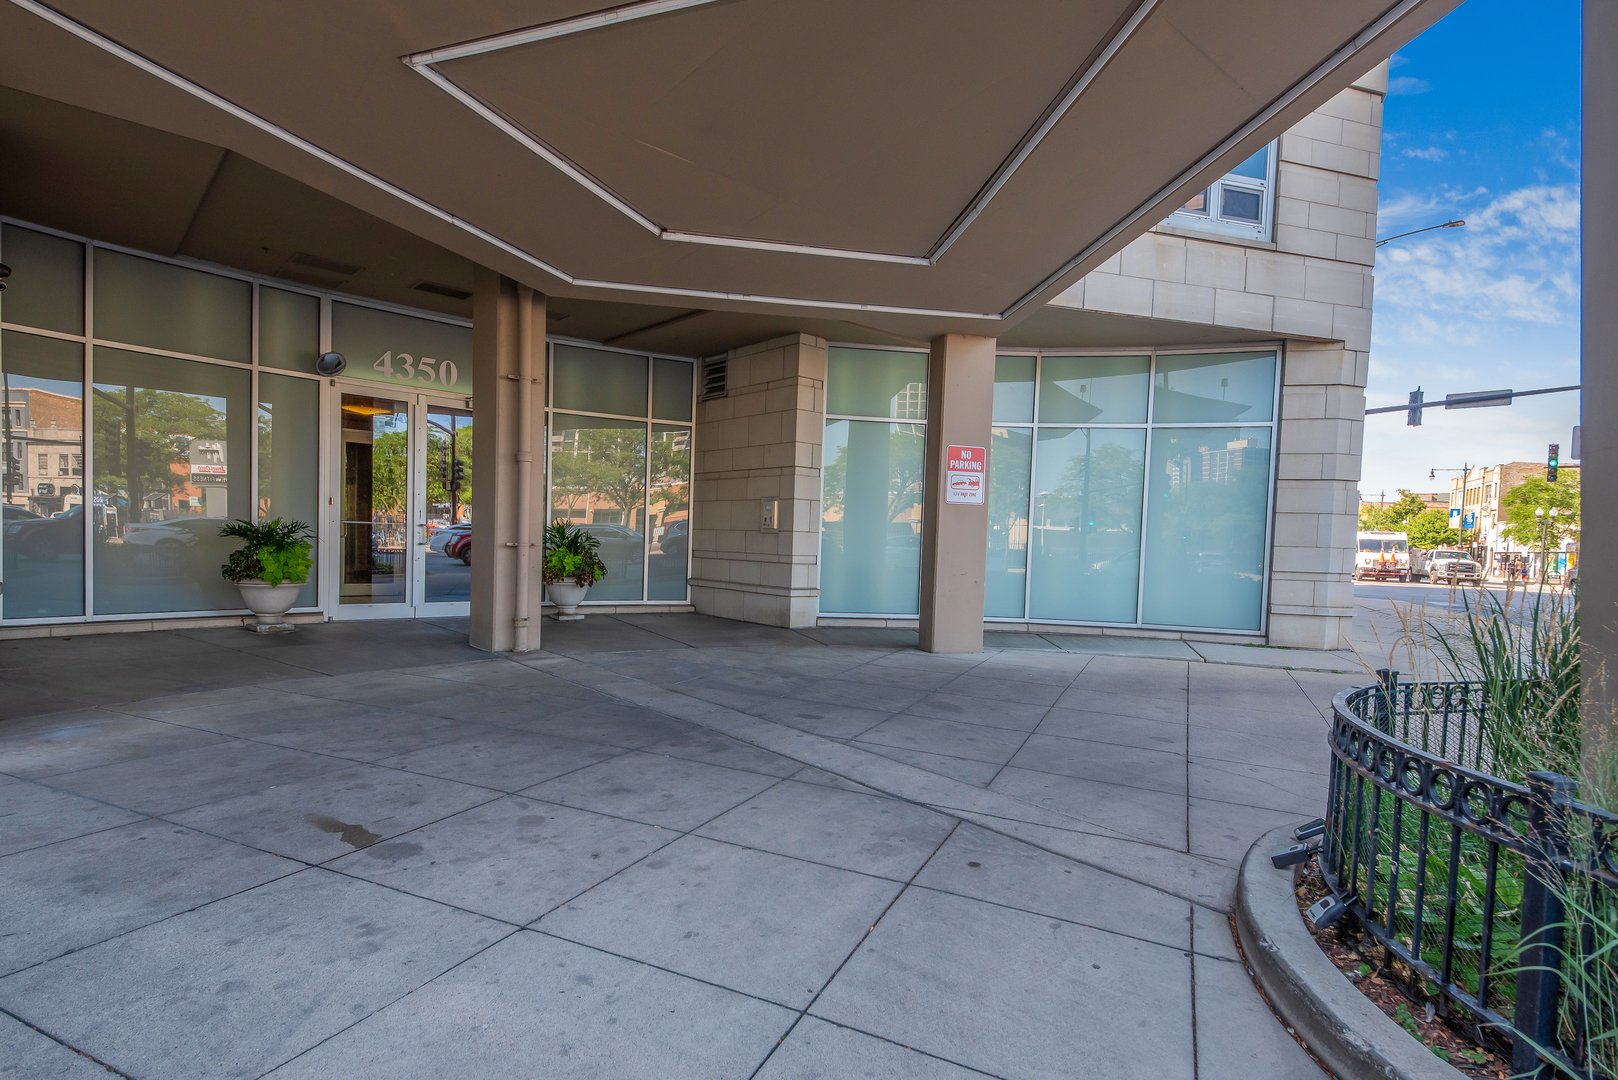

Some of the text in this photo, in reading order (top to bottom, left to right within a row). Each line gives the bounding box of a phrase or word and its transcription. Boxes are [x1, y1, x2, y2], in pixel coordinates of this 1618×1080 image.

[373, 350, 458, 387] 4350
[961, 450, 972, 459] NO
[950, 460, 982, 470] PARKING
